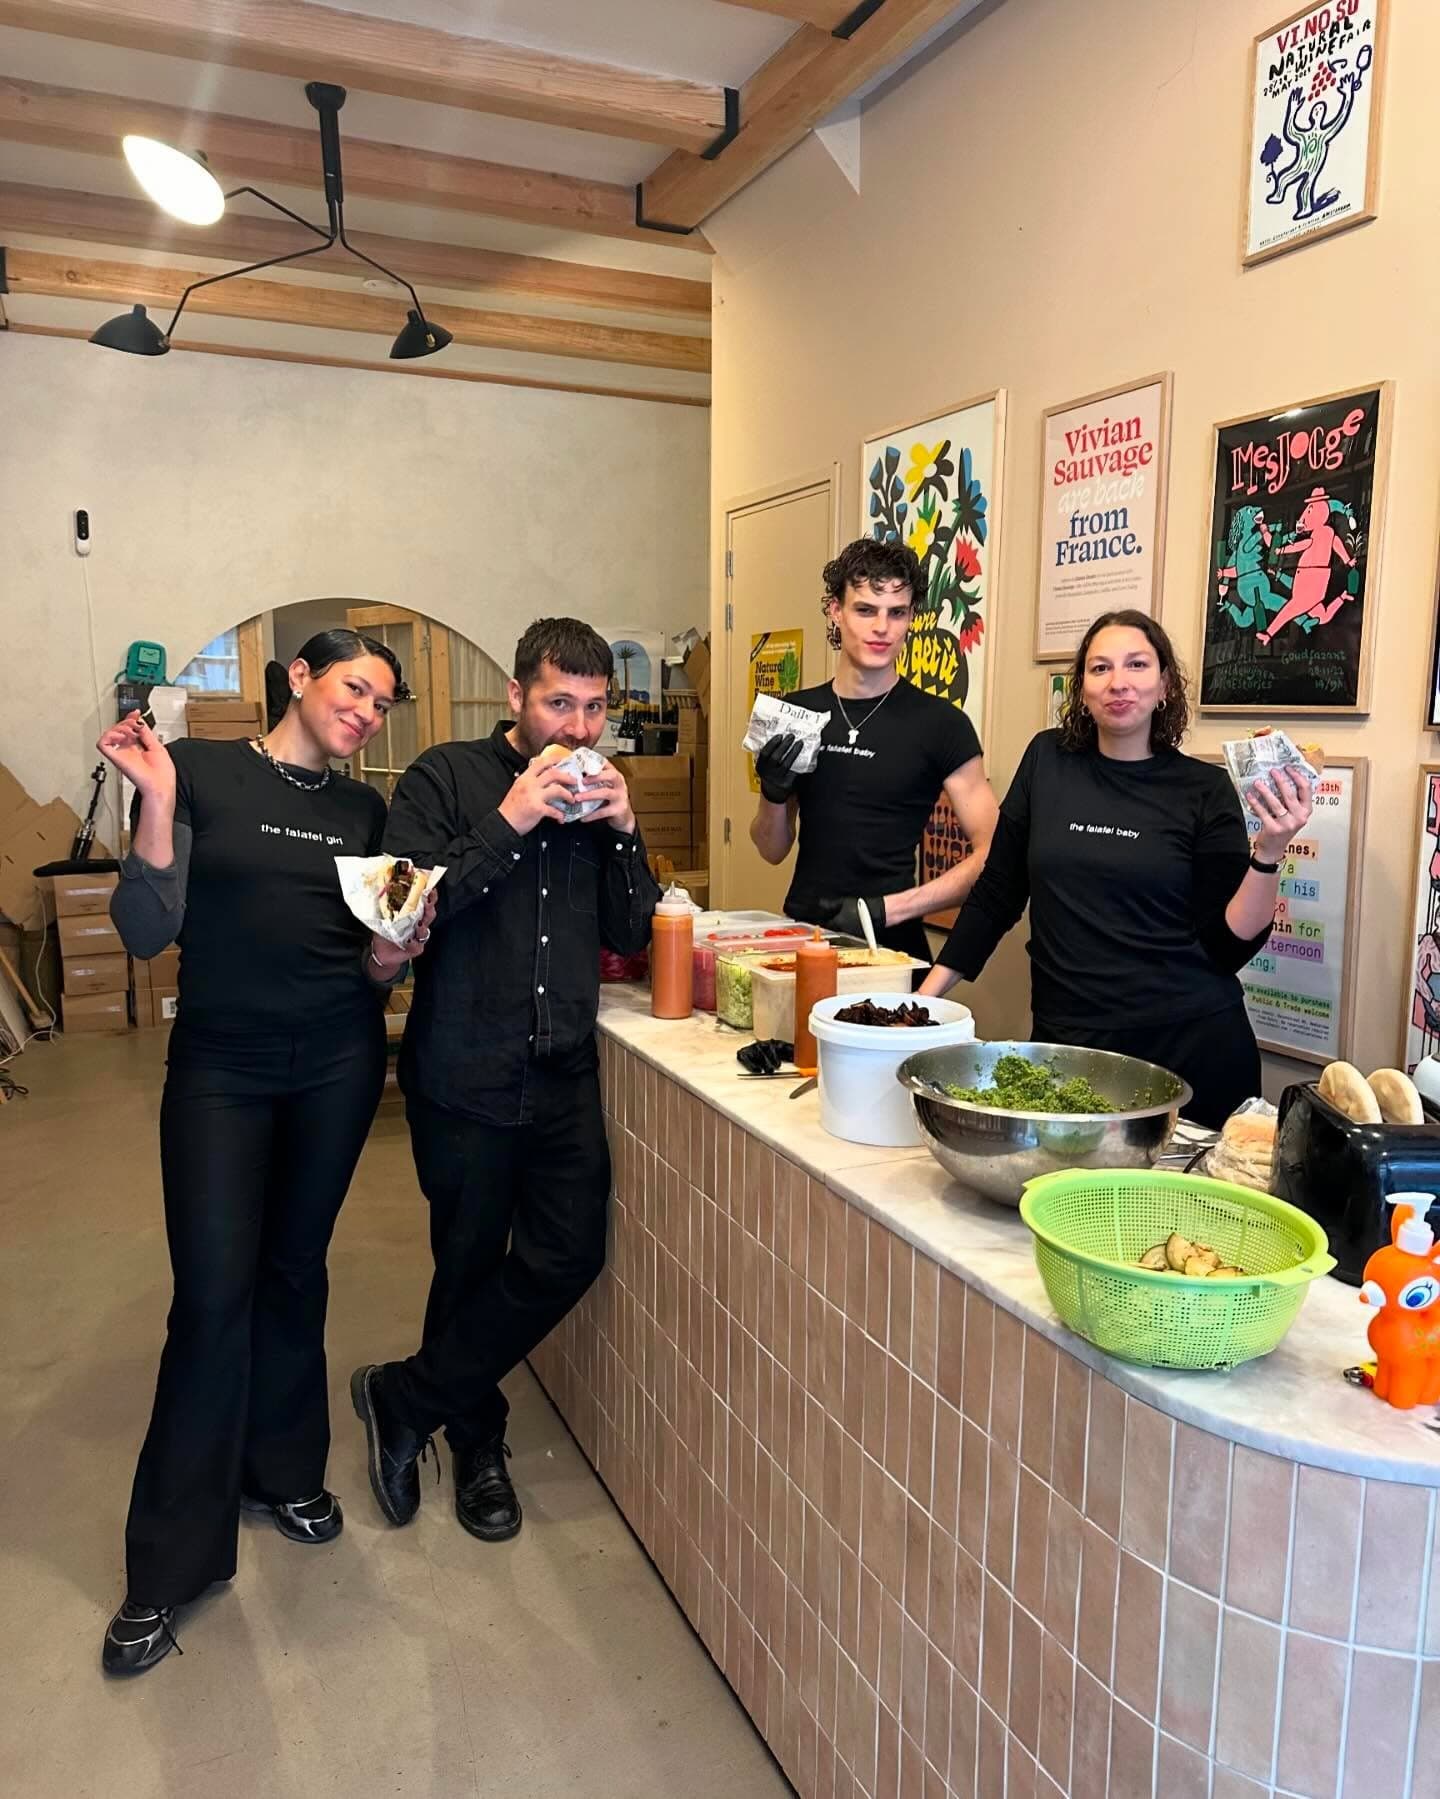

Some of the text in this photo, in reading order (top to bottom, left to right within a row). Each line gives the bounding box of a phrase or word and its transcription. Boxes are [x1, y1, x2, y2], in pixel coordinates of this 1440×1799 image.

[1269, 16, 1354, 80] NATURAL
[1065, 416, 1142, 457] Vivian
[1053, 442, 1153, 486] Sauvage
[1057, 474, 1145, 513] are back
[1069, 506, 1129, 539] from
[1055, 531, 1142, 566] France.
[910, 611, 937, 633] ure
[756, 661, 785, 673] Natural
[755, 674, 775, 686] Wine
[853, 747, 876, 759] baby
[1321, 783, 1340, 792] 13th
[261, 823, 343, 845] the falafel girl
[1069, 822, 1140, 839] the falafel baby
[1284, 844, 1316, 858] nes,
[1279, 880, 1316, 897] f his
[1299, 923, 1320, 937] for
[1264, 938, 1321, 959] ternoon
[1249, 957, 1275, 972] ing.
[1252, 995, 1273, 1006] Public
[1284, 1001, 1301, 1012] Trade
